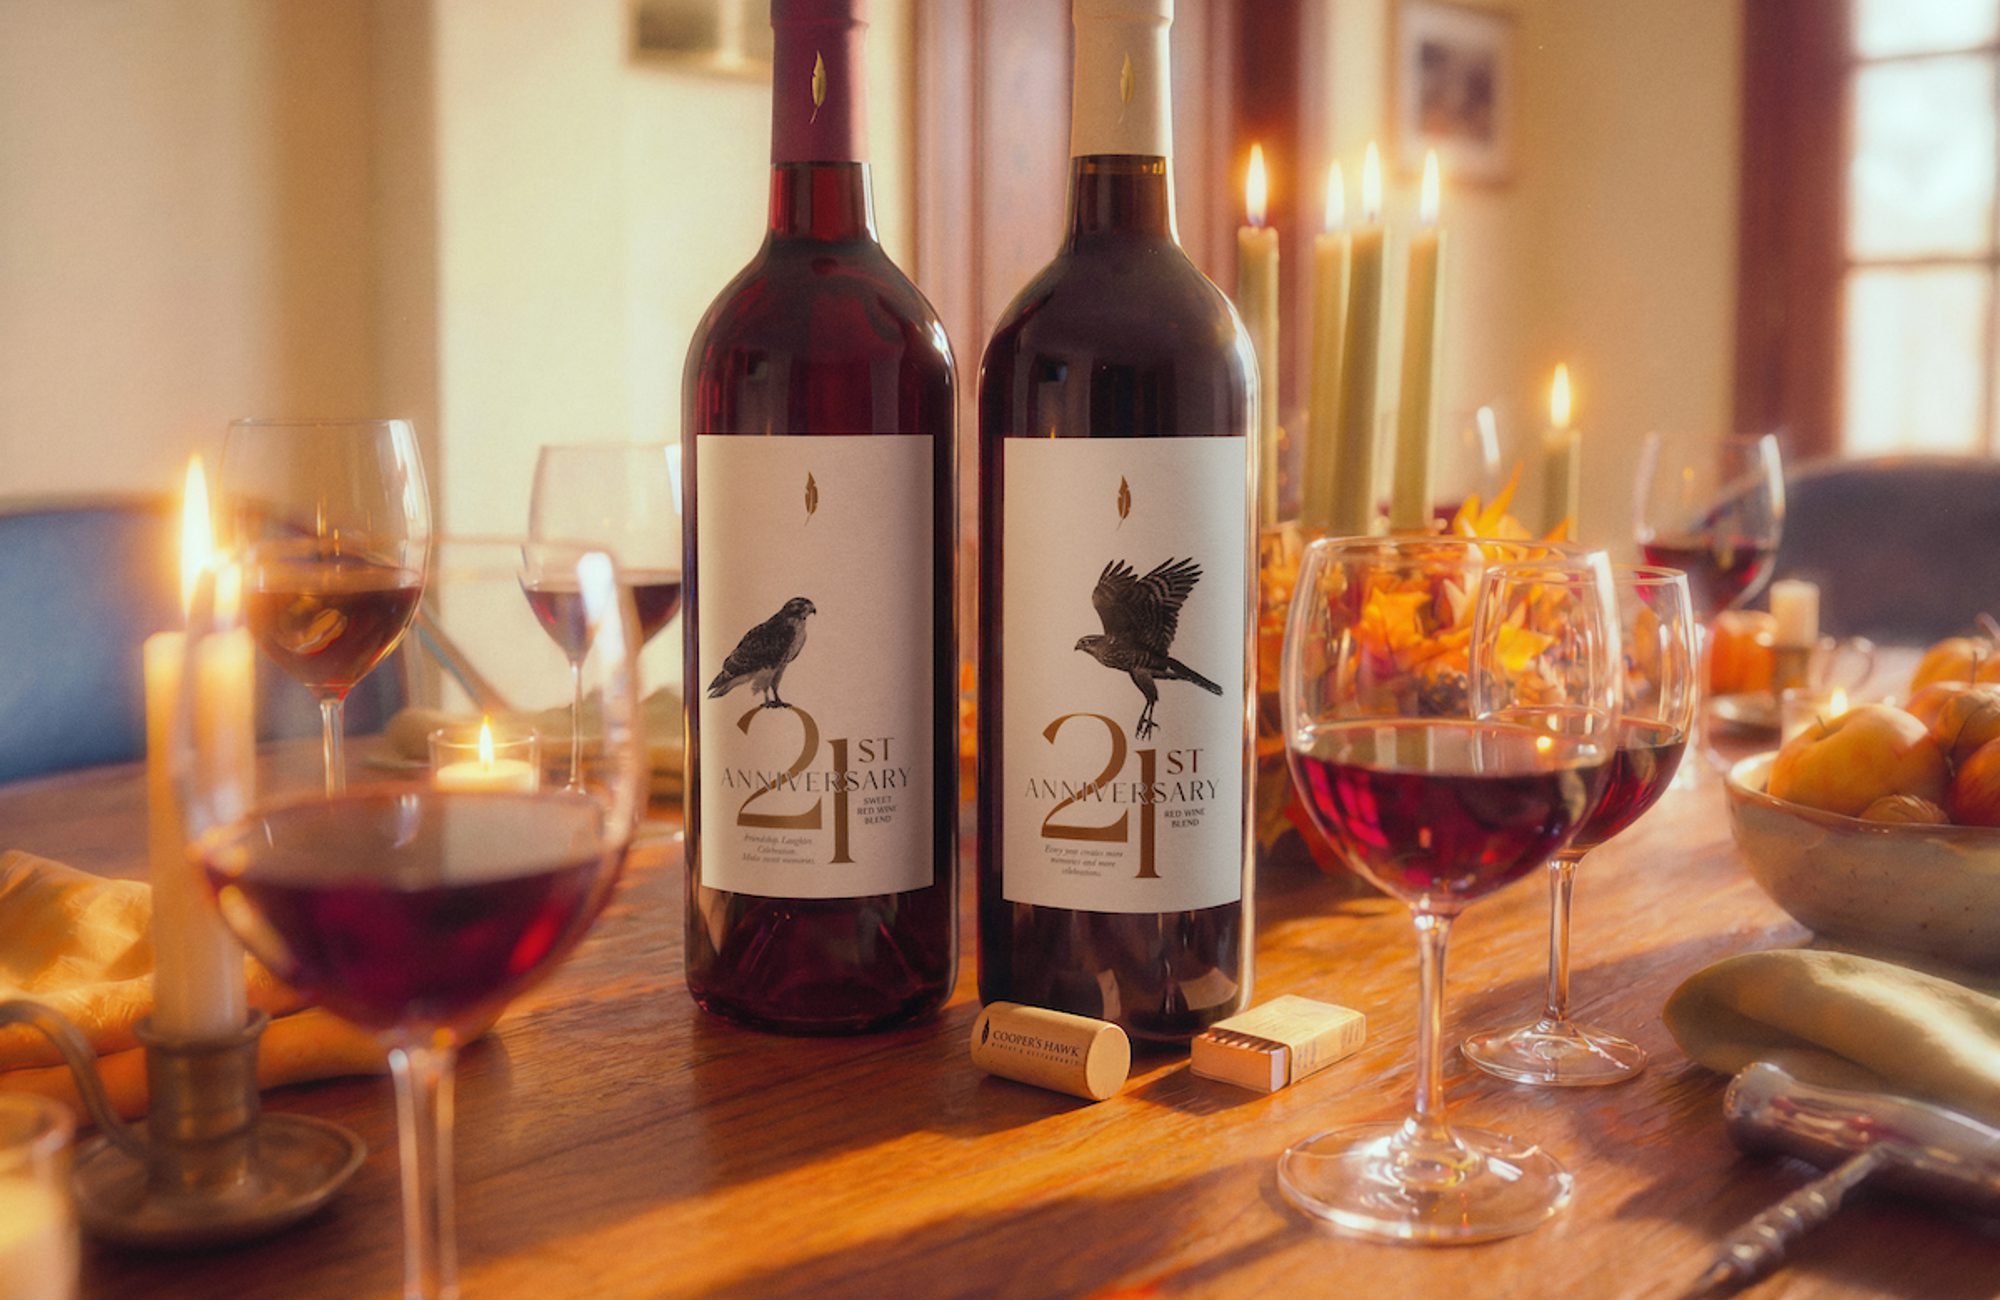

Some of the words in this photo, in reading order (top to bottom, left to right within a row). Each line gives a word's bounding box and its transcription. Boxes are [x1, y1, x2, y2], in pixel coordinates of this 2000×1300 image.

[721, 767, 912, 793] ANNIVERSARY
[1025, 778, 1219, 804] ANNIVERSARY
[863, 796, 892, 805] SWEET
[857, 807, 875, 816] RED
[877, 804, 897, 814] WINE
[1164, 810, 1182, 818] RED
[1183, 807, 1205, 817] WINE
[864, 815, 892, 825] BLEND
[1171, 818, 1200, 828] BLEND
[993, 1030, 1042, 1050] COOPER'S
[1044, 1041, 1081, 1058] HAWK
